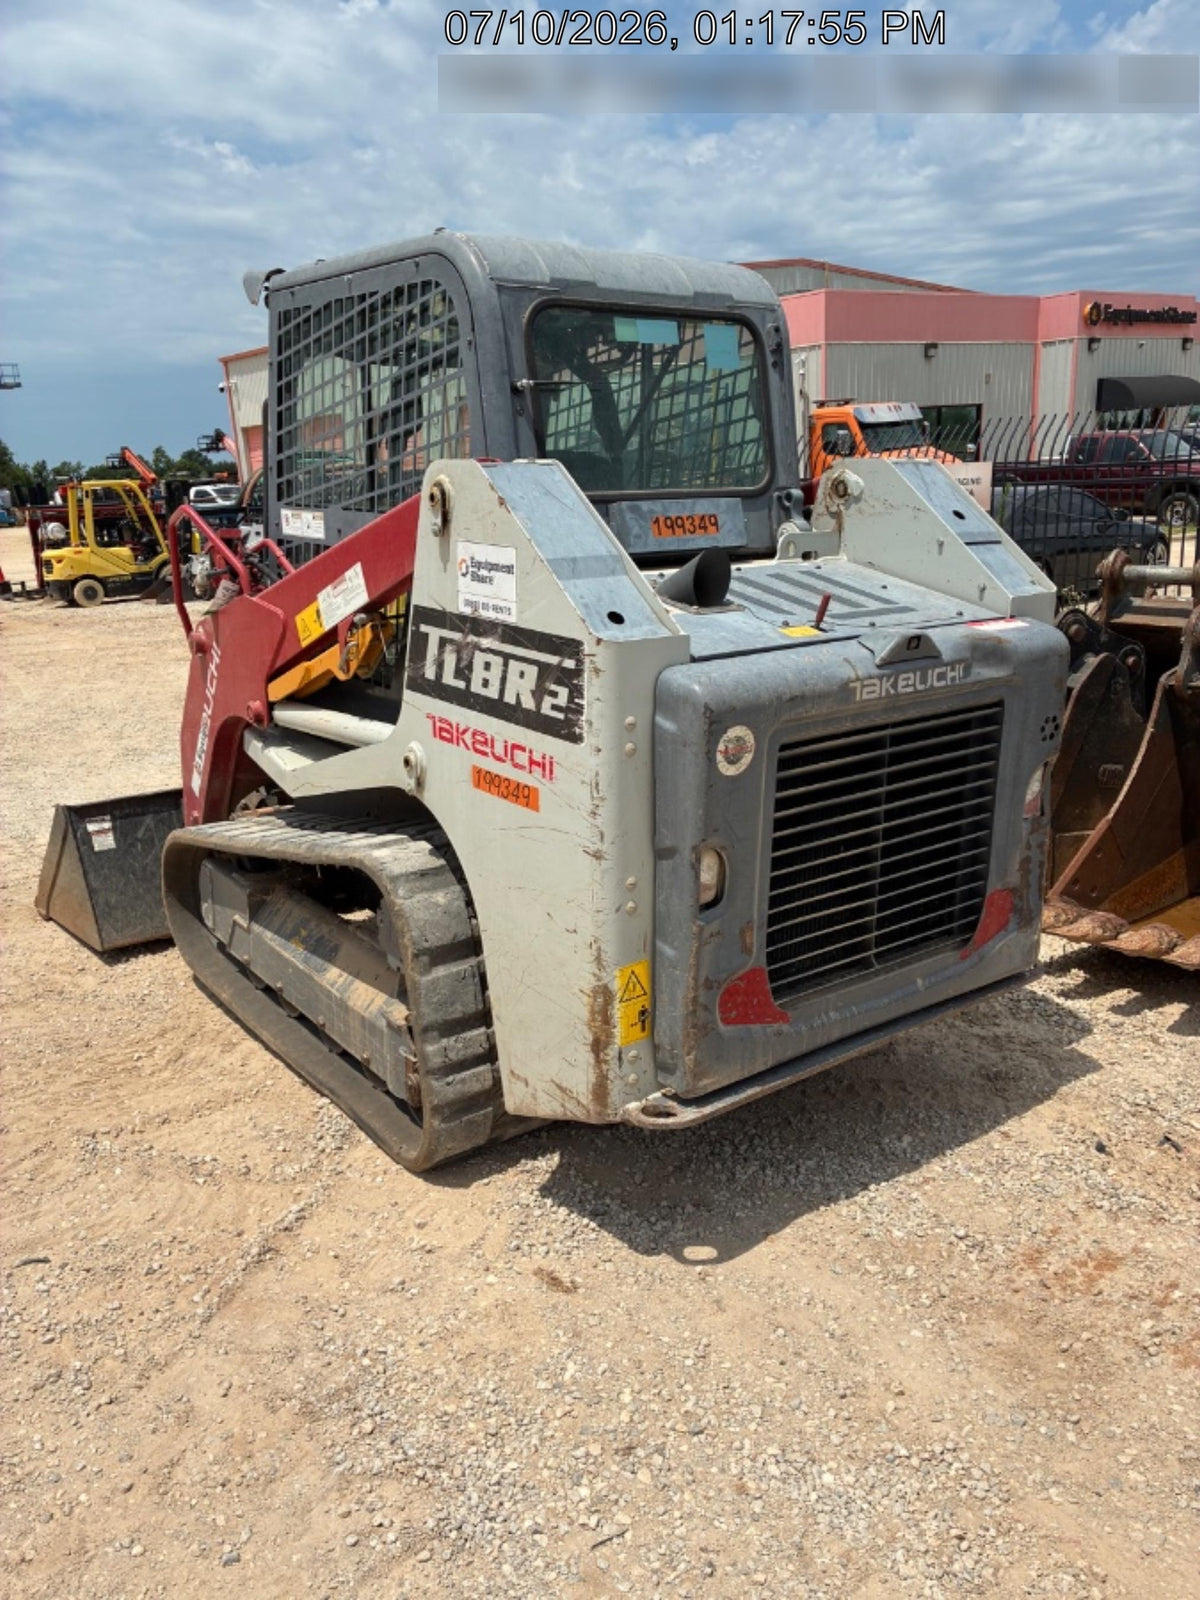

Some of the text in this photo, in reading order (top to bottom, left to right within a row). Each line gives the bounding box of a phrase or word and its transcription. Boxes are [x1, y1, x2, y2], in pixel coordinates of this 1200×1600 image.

[652, 514, 719, 536] 199349
[470, 556, 515, 575] Equipment
[426, 713, 555, 782] TAKEUCHI
[474, 767, 532, 808] 199349
